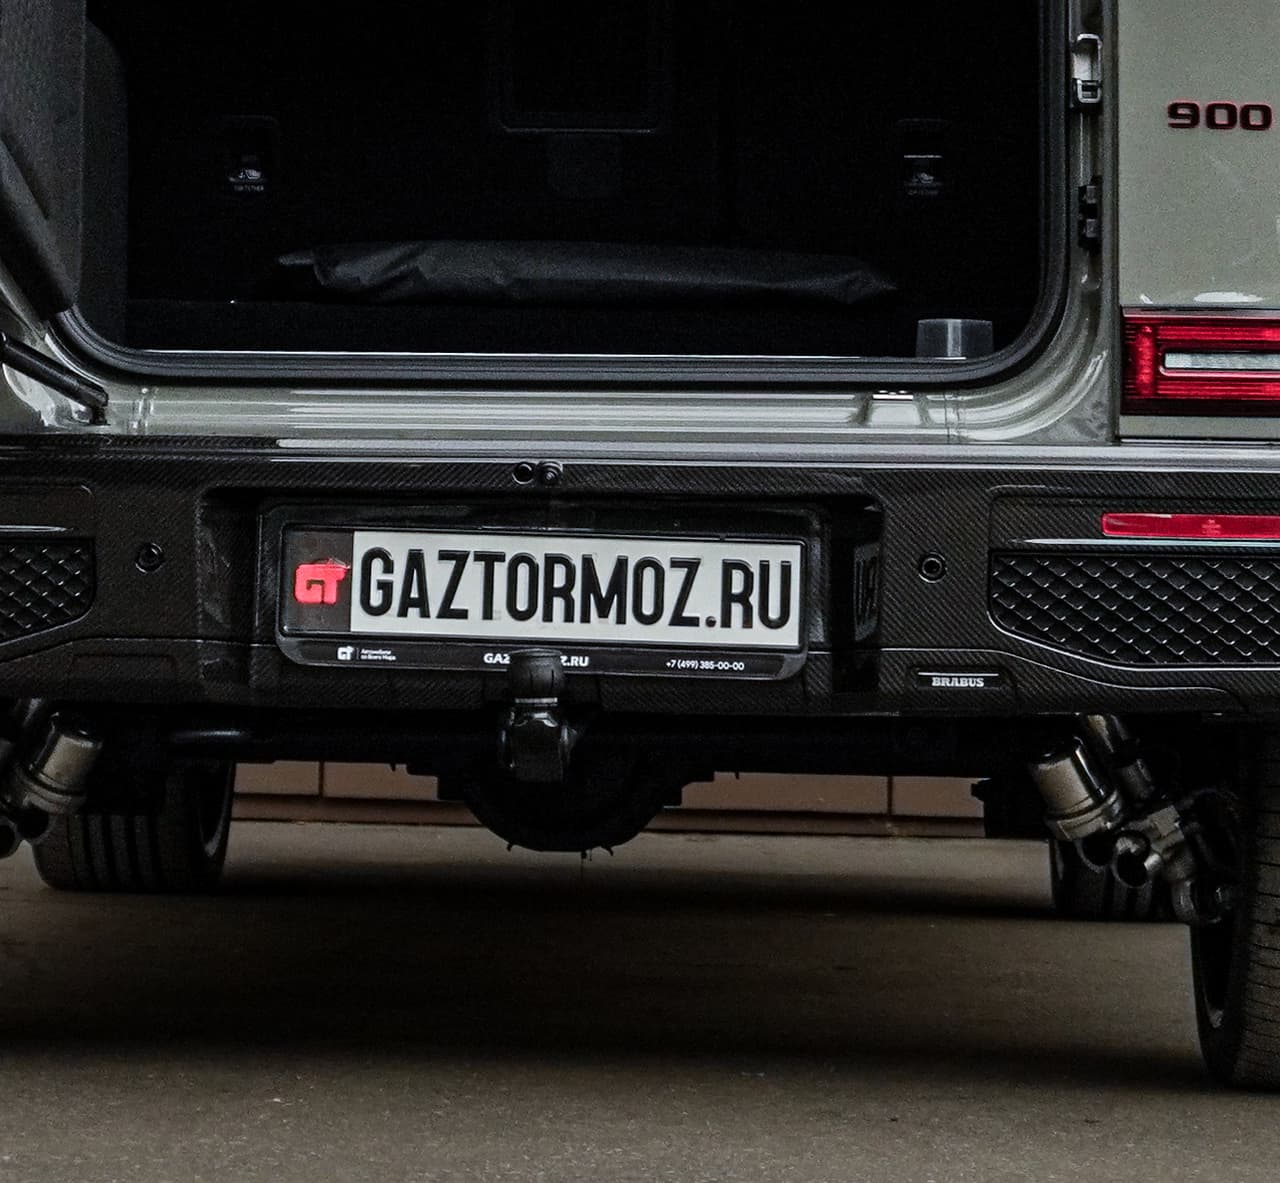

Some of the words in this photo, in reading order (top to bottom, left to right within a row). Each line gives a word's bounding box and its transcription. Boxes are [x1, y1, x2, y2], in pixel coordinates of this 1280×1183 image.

[1167, 101, 1272, 131] 900
[359, 546, 793, 629] GAZTORMOZ.RU
[666, 659, 677, 668] +7
[931, 676, 985, 687] BRABUS
